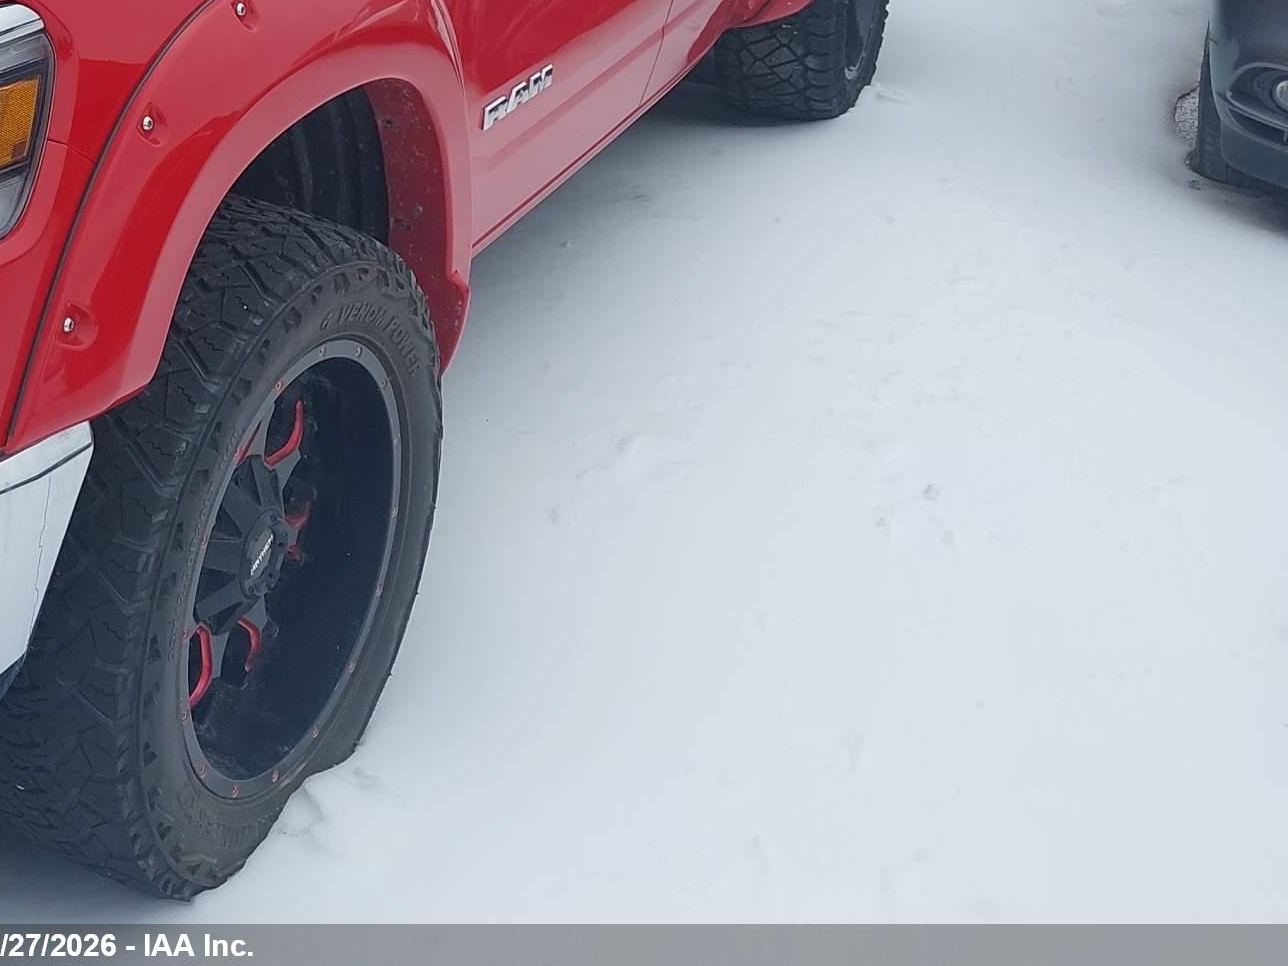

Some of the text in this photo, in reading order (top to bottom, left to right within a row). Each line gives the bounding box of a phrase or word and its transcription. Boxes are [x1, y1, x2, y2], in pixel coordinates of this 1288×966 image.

[482, 63, 553, 131] RAM
[338, 301, 422, 378] VENOM POWER
